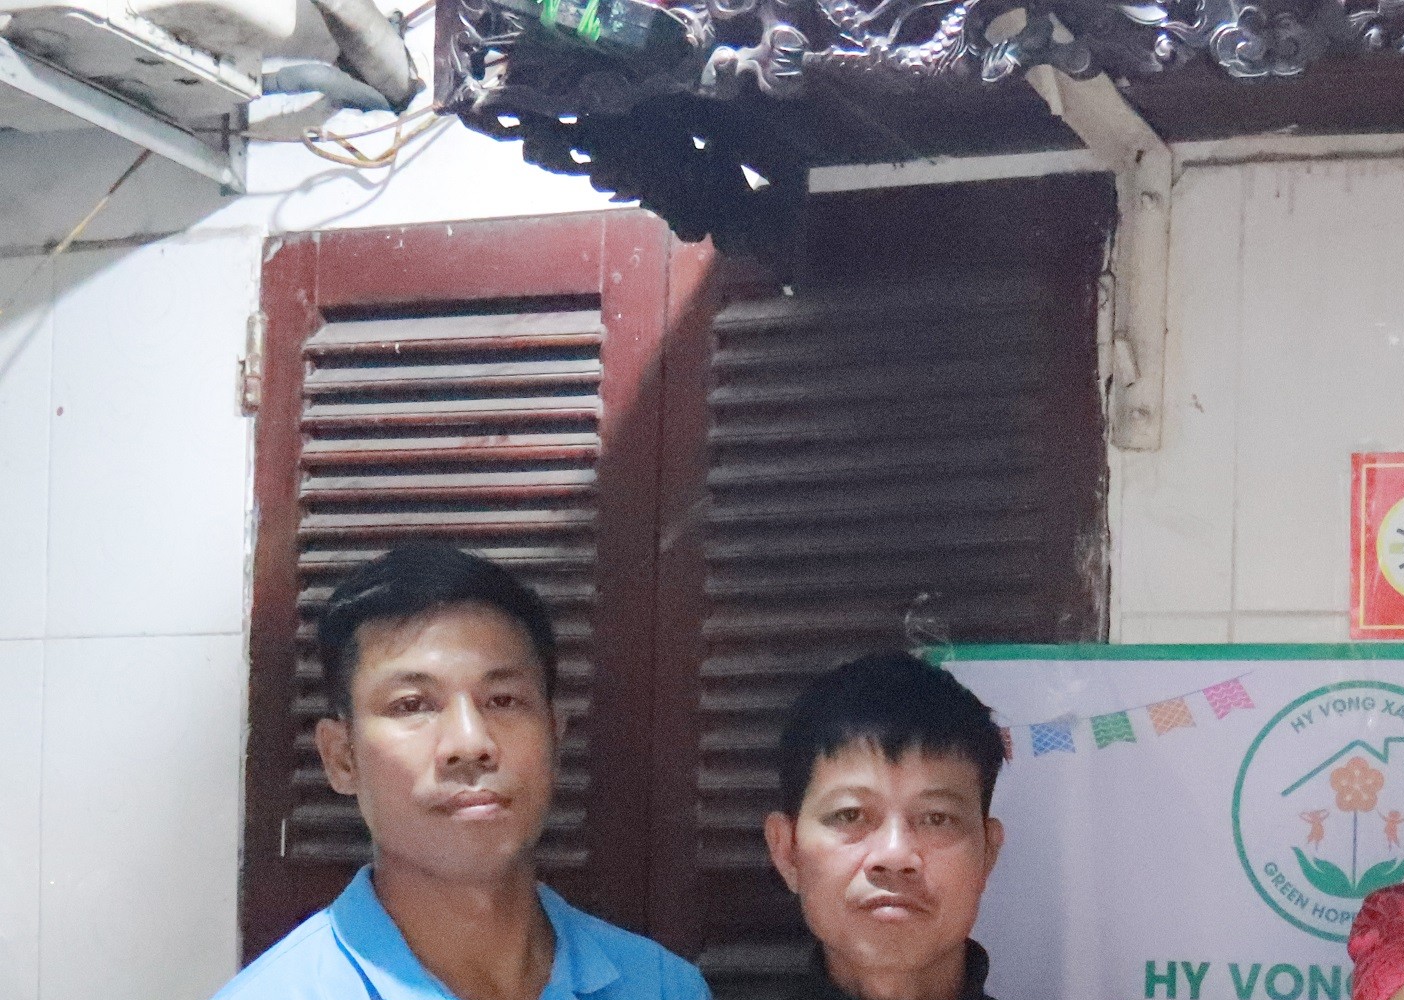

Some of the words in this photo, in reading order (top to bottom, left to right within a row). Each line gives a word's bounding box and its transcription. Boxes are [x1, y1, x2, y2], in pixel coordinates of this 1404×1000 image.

[1290, 710, 1320, 734] HY
[1318, 696, 1377, 717] VỌNG
[1264, 861, 1309, 910] GREEN
[1311, 902, 1357, 925] HOP
[1144, 960, 1211, 1000] HY
